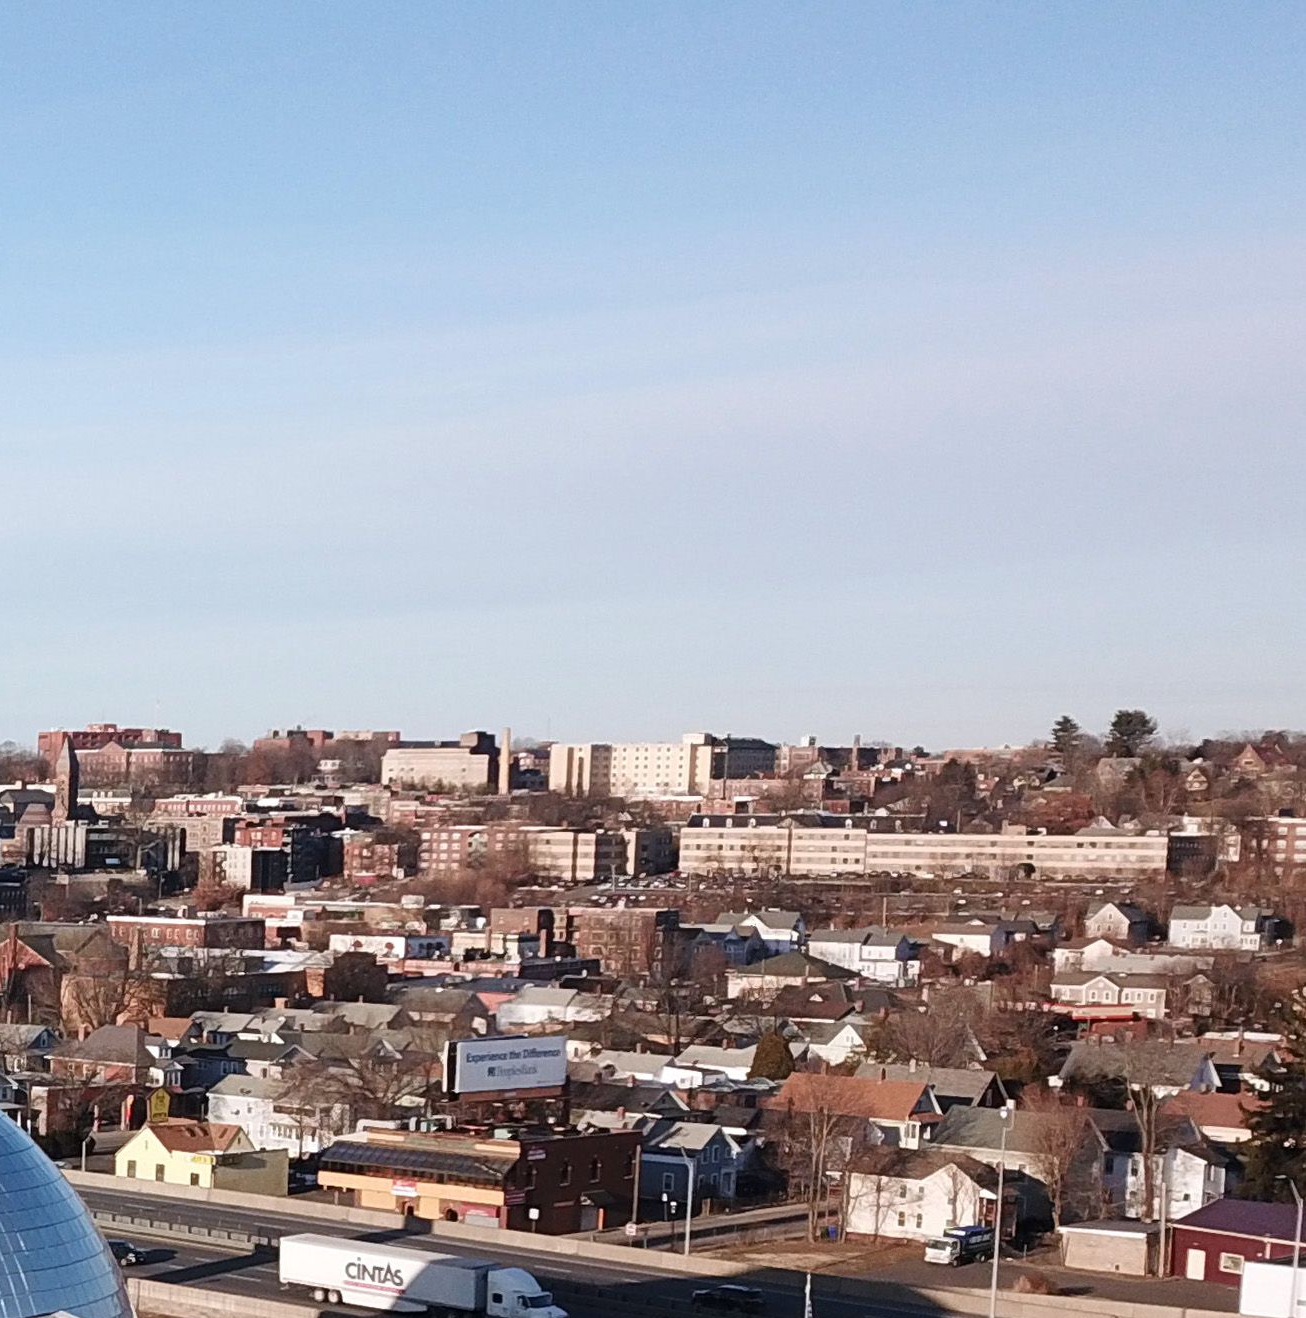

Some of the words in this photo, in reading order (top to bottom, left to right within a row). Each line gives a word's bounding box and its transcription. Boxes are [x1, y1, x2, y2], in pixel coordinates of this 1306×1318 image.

[467, 1052, 508, 1063] Experience
[509, 1051, 521, 1059] the
[523, 1048, 561, 1059] Difference
